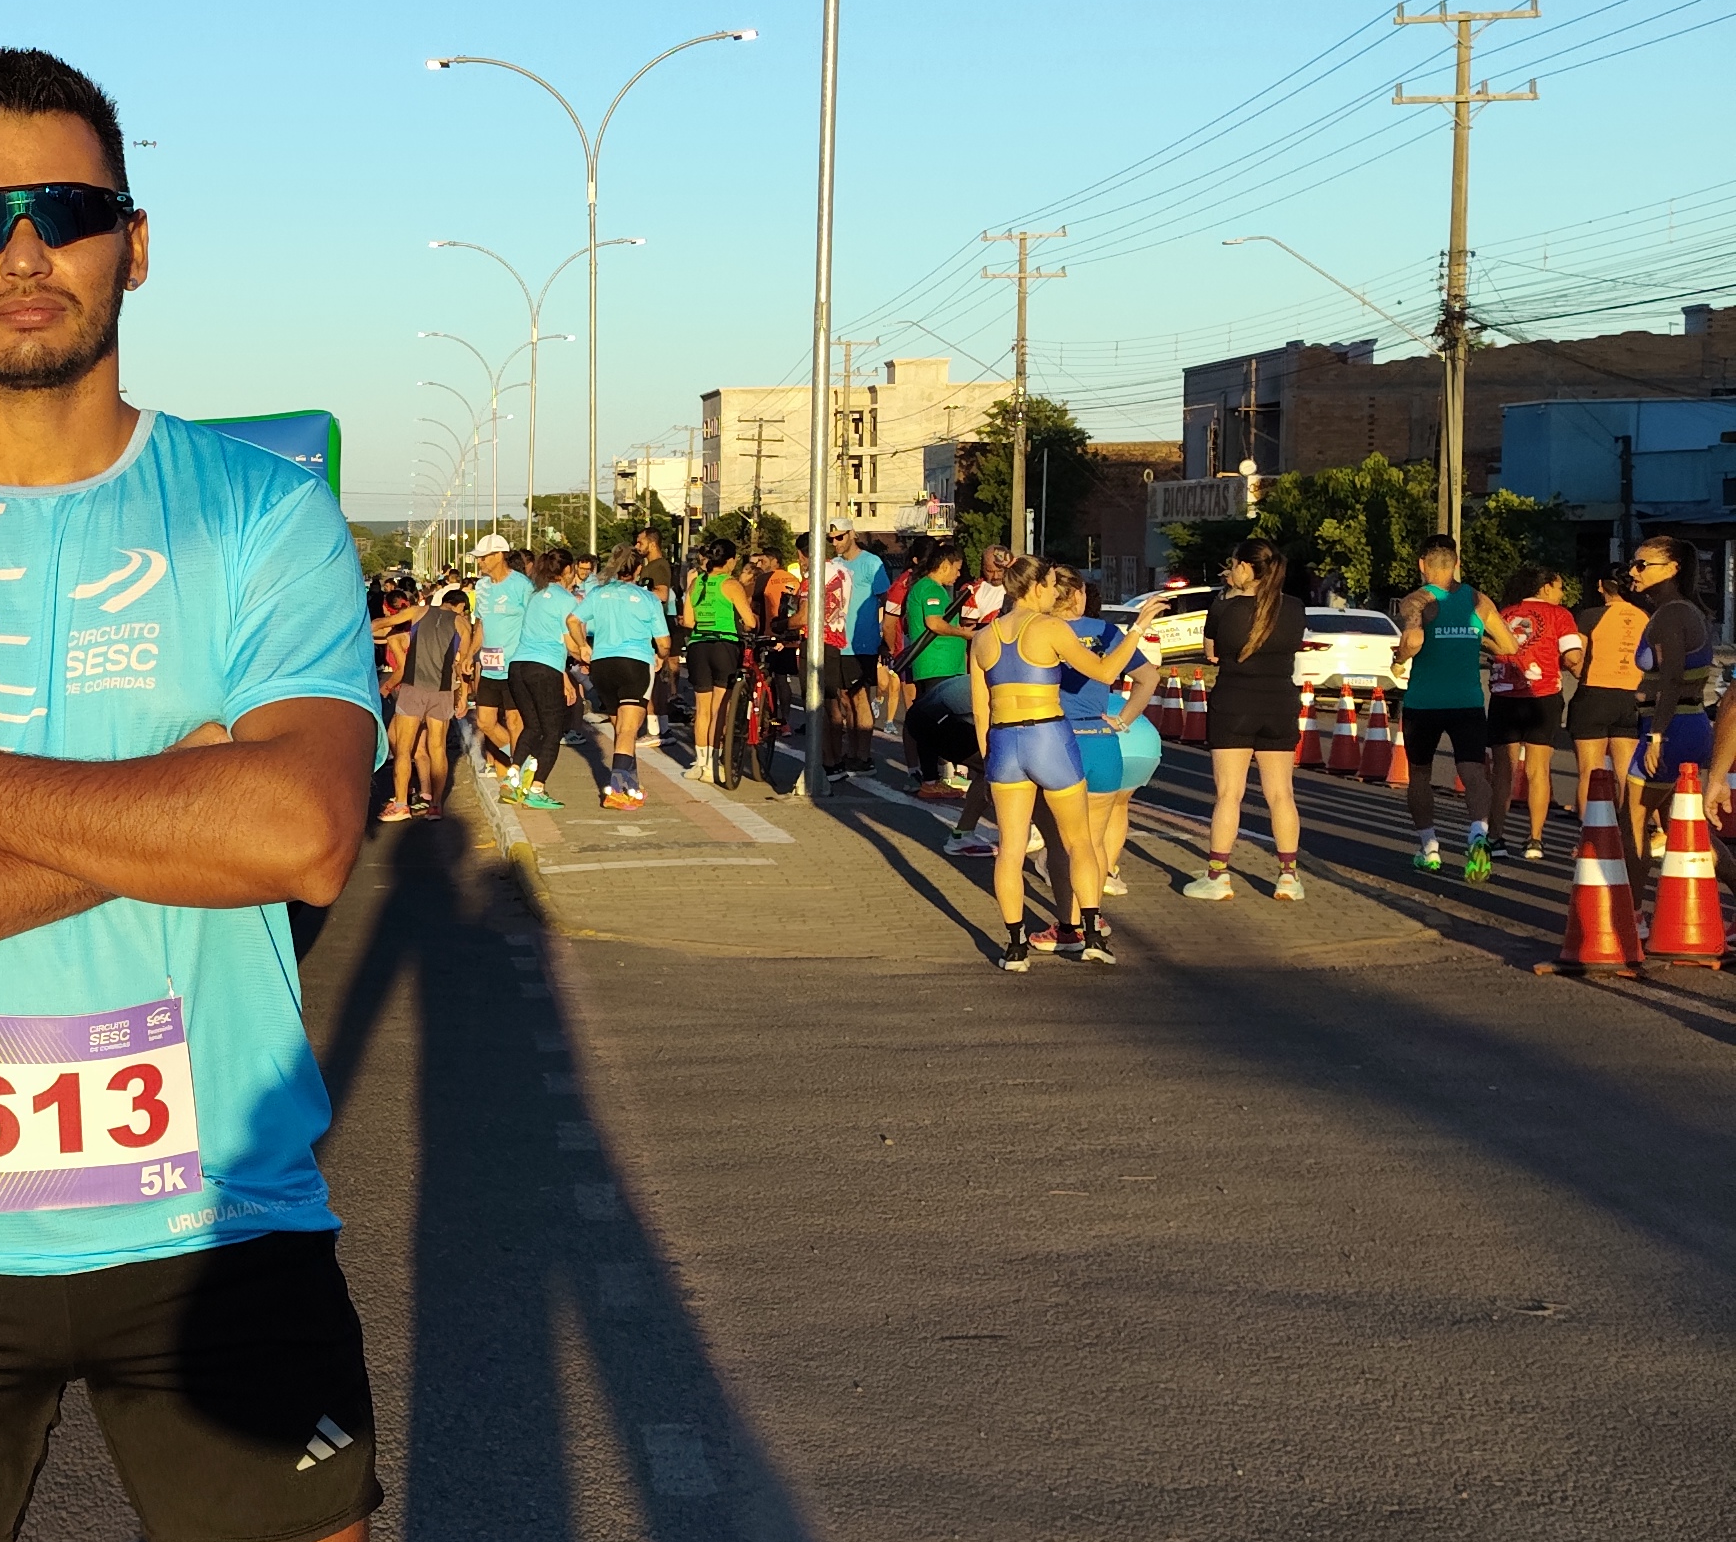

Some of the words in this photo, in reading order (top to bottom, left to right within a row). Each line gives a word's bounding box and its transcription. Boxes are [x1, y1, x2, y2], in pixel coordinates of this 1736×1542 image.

[1163, 483, 1230, 519] BICICLETAS
[68, 623, 160, 647] CIRCUITO
[66, 643, 159, 678] SESC
[483, 654, 501, 665] 571
[84, 677, 156, 693] CORRIDAS
[89, 1020, 130, 1033] CIRCUITO
[89, 1029, 131, 1046] SESC
[140, 1162, 188, 1196] 5k
[167, 1201, 269, 1234] URUGUAIAN
